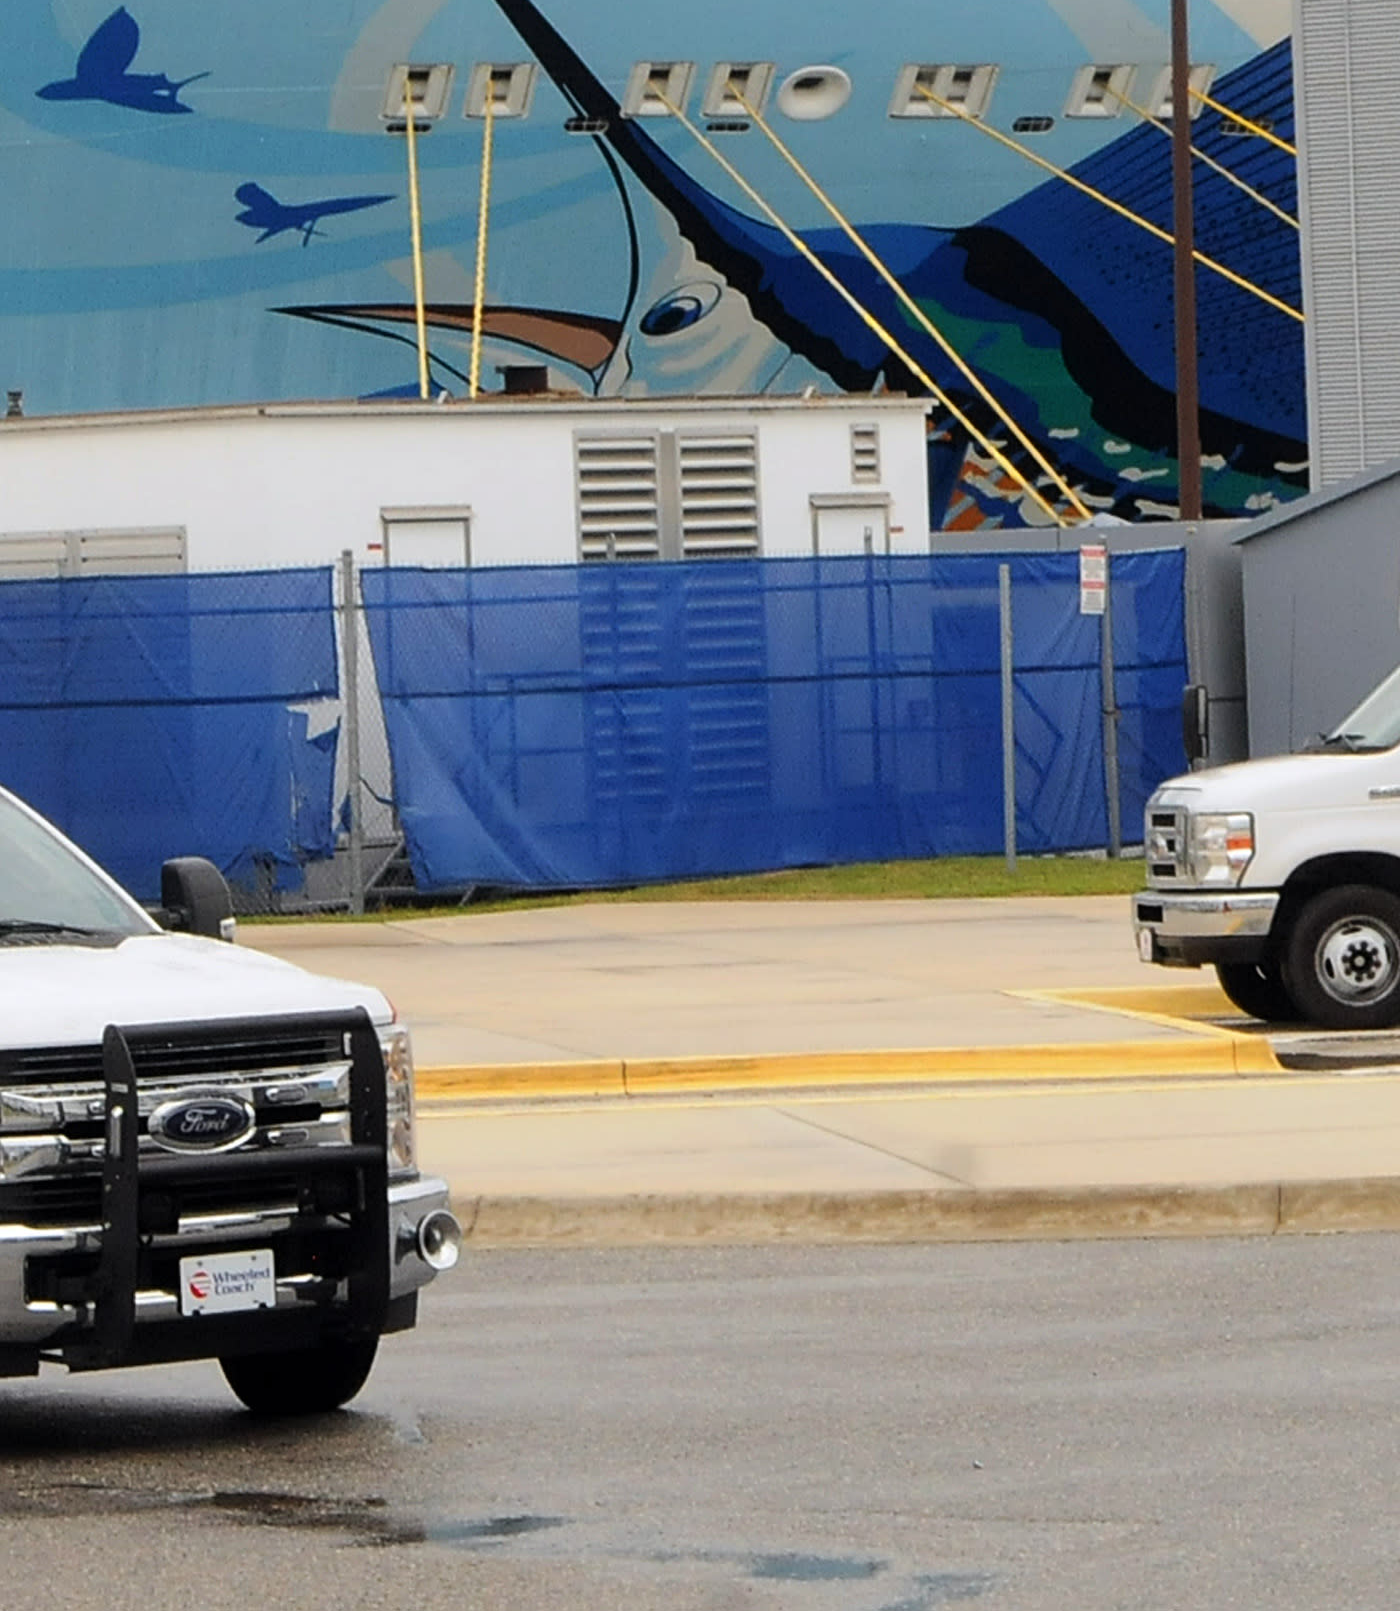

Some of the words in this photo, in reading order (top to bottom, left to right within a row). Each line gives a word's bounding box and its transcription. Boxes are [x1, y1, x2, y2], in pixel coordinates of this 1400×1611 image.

[180, 1108, 231, 1134] Ford
[212, 1267, 270, 1284] Wheeled
[214, 1282, 255, 1296] Coach
